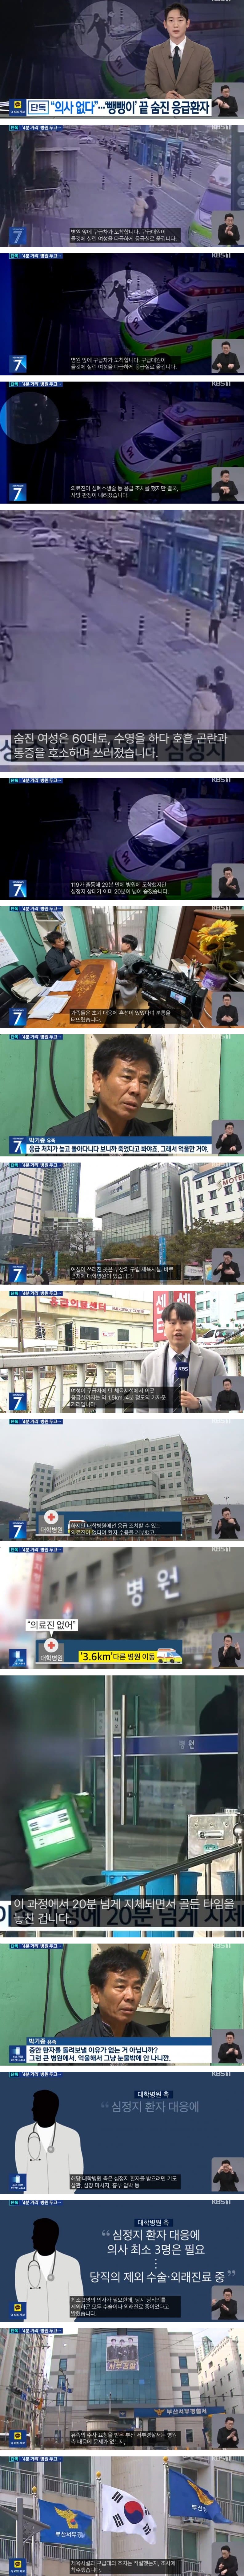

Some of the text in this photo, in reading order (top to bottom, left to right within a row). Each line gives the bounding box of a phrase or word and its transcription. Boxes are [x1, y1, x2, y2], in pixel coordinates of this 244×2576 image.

[50, 1296, 106, 1312] 응급의료센터
[126, 1566, 181, 1607] 병원
[179, 1740, 194, 1749] 병원
